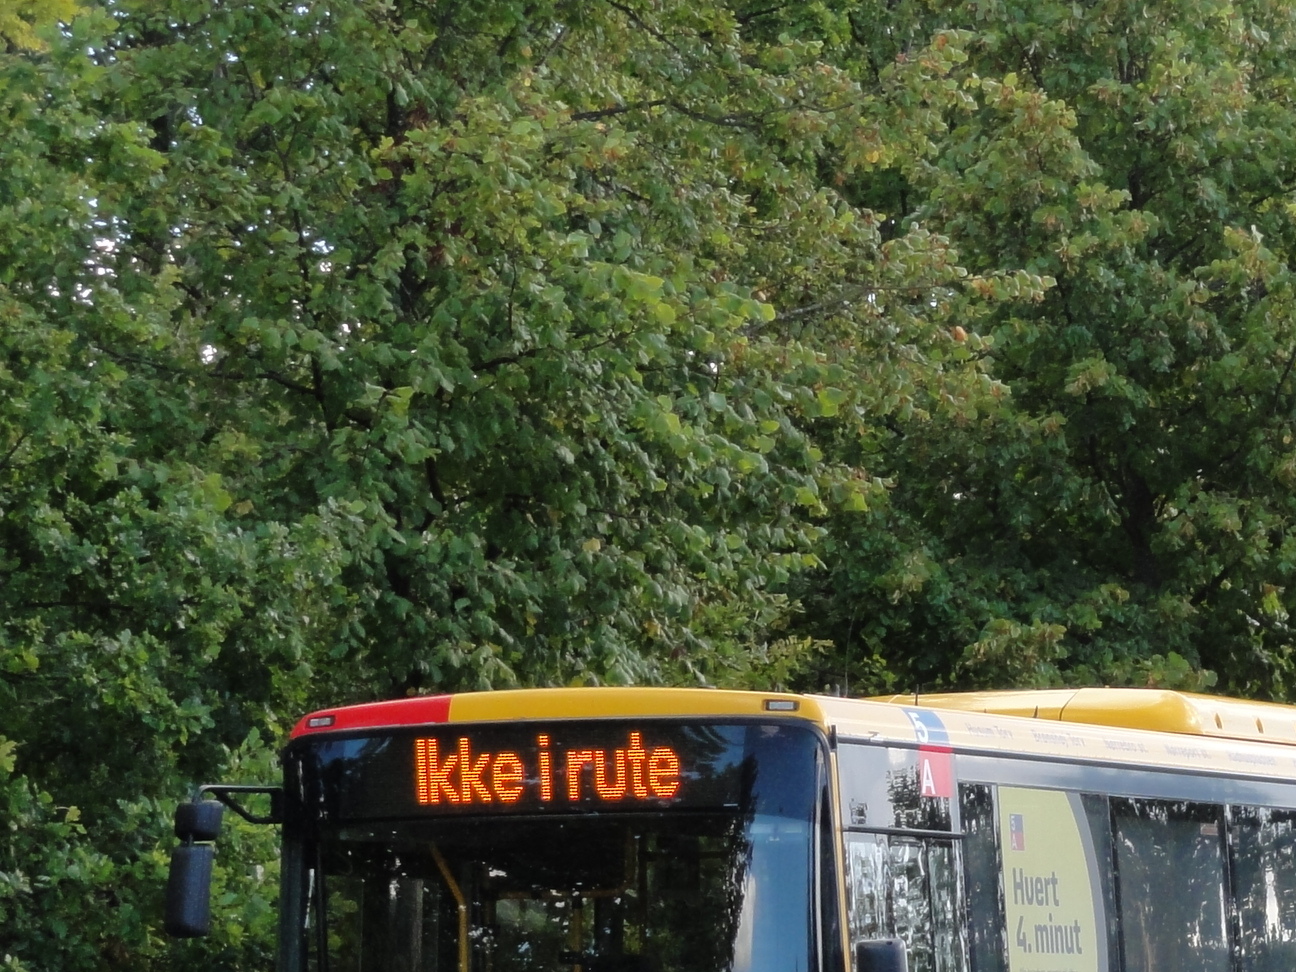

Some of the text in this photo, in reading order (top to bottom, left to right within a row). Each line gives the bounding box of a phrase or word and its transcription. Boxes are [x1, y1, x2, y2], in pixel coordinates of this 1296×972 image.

[908, 712, 929, 743] 5
[416, 731, 680, 803] Ikke i rute
[922, 759, 936, 795] A
[1016, 912, 1083, 955] 4. minut
